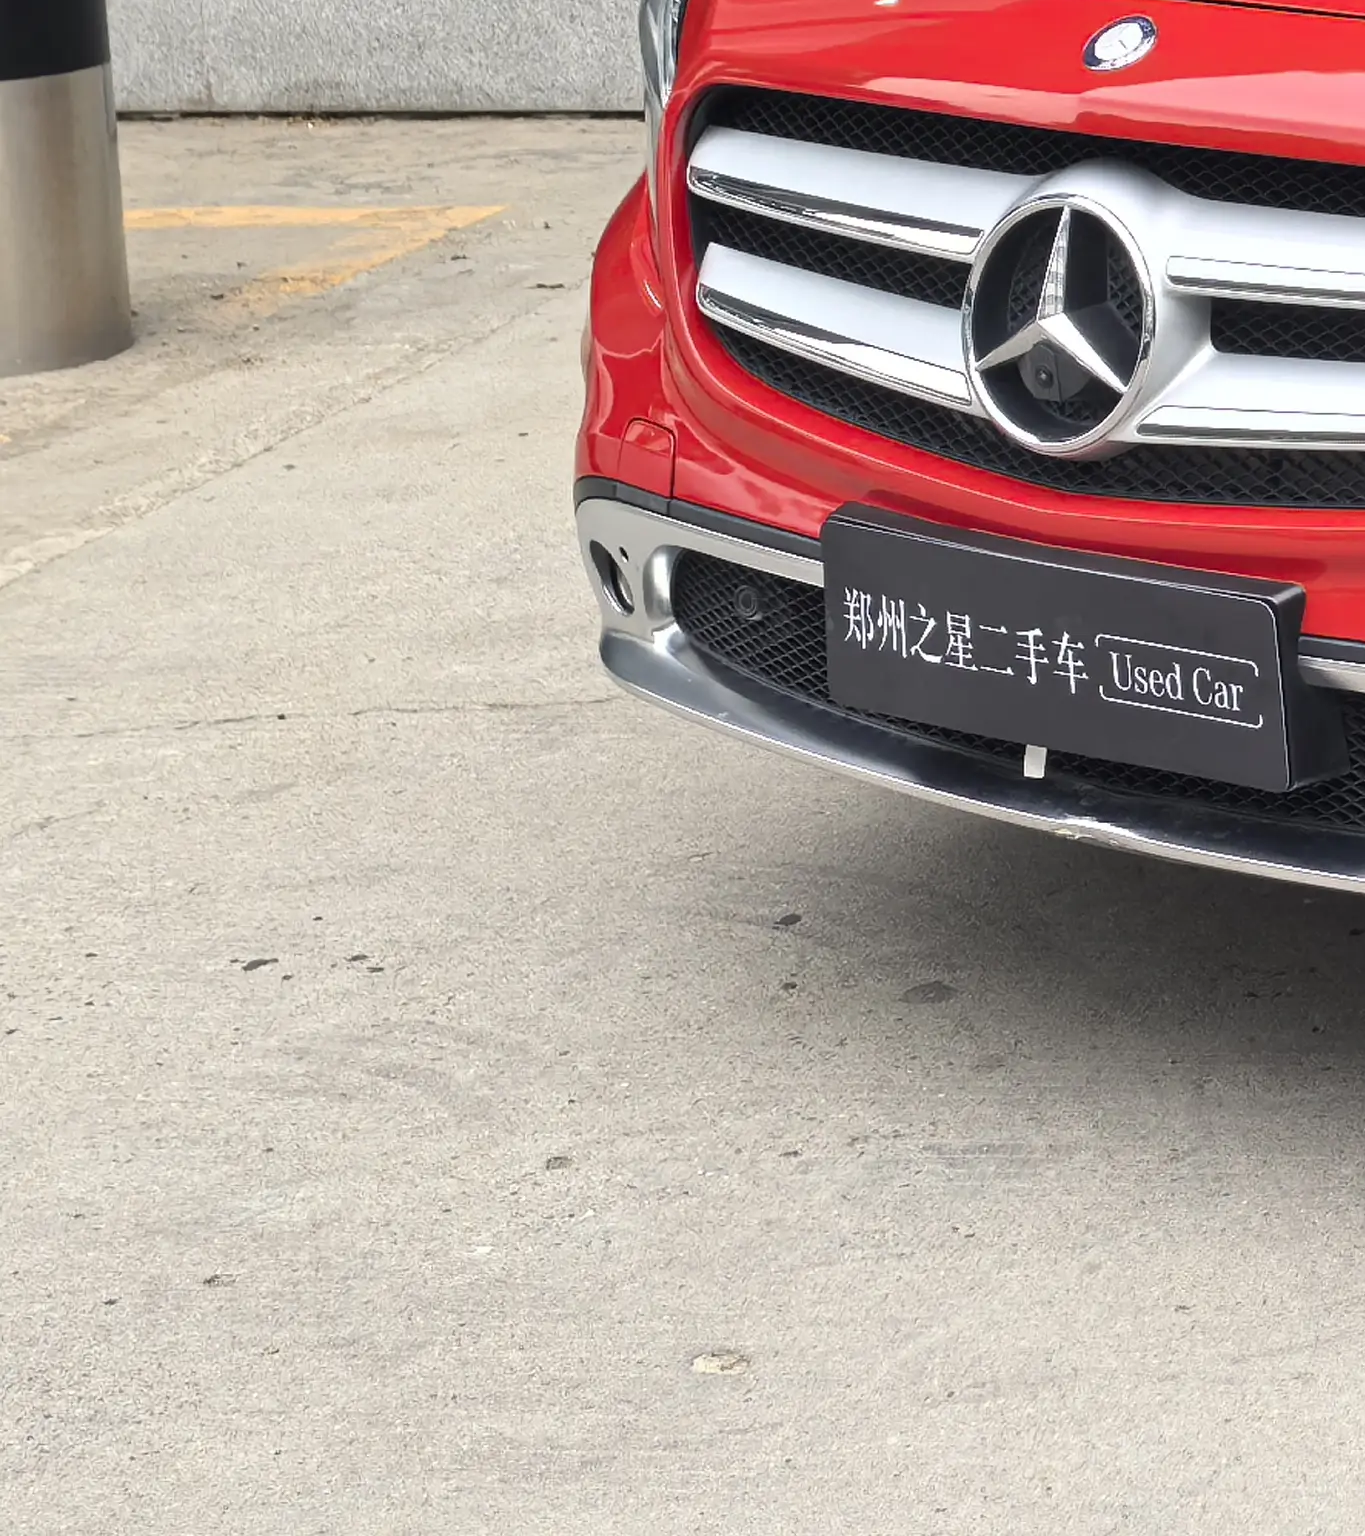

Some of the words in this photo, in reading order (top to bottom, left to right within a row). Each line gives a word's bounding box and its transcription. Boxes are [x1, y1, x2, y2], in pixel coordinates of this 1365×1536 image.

[842, 586, 1089, 695] 郑州之星二手车
[1108, 651, 1186, 701] Used
[1192, 667, 1244, 713] Car
